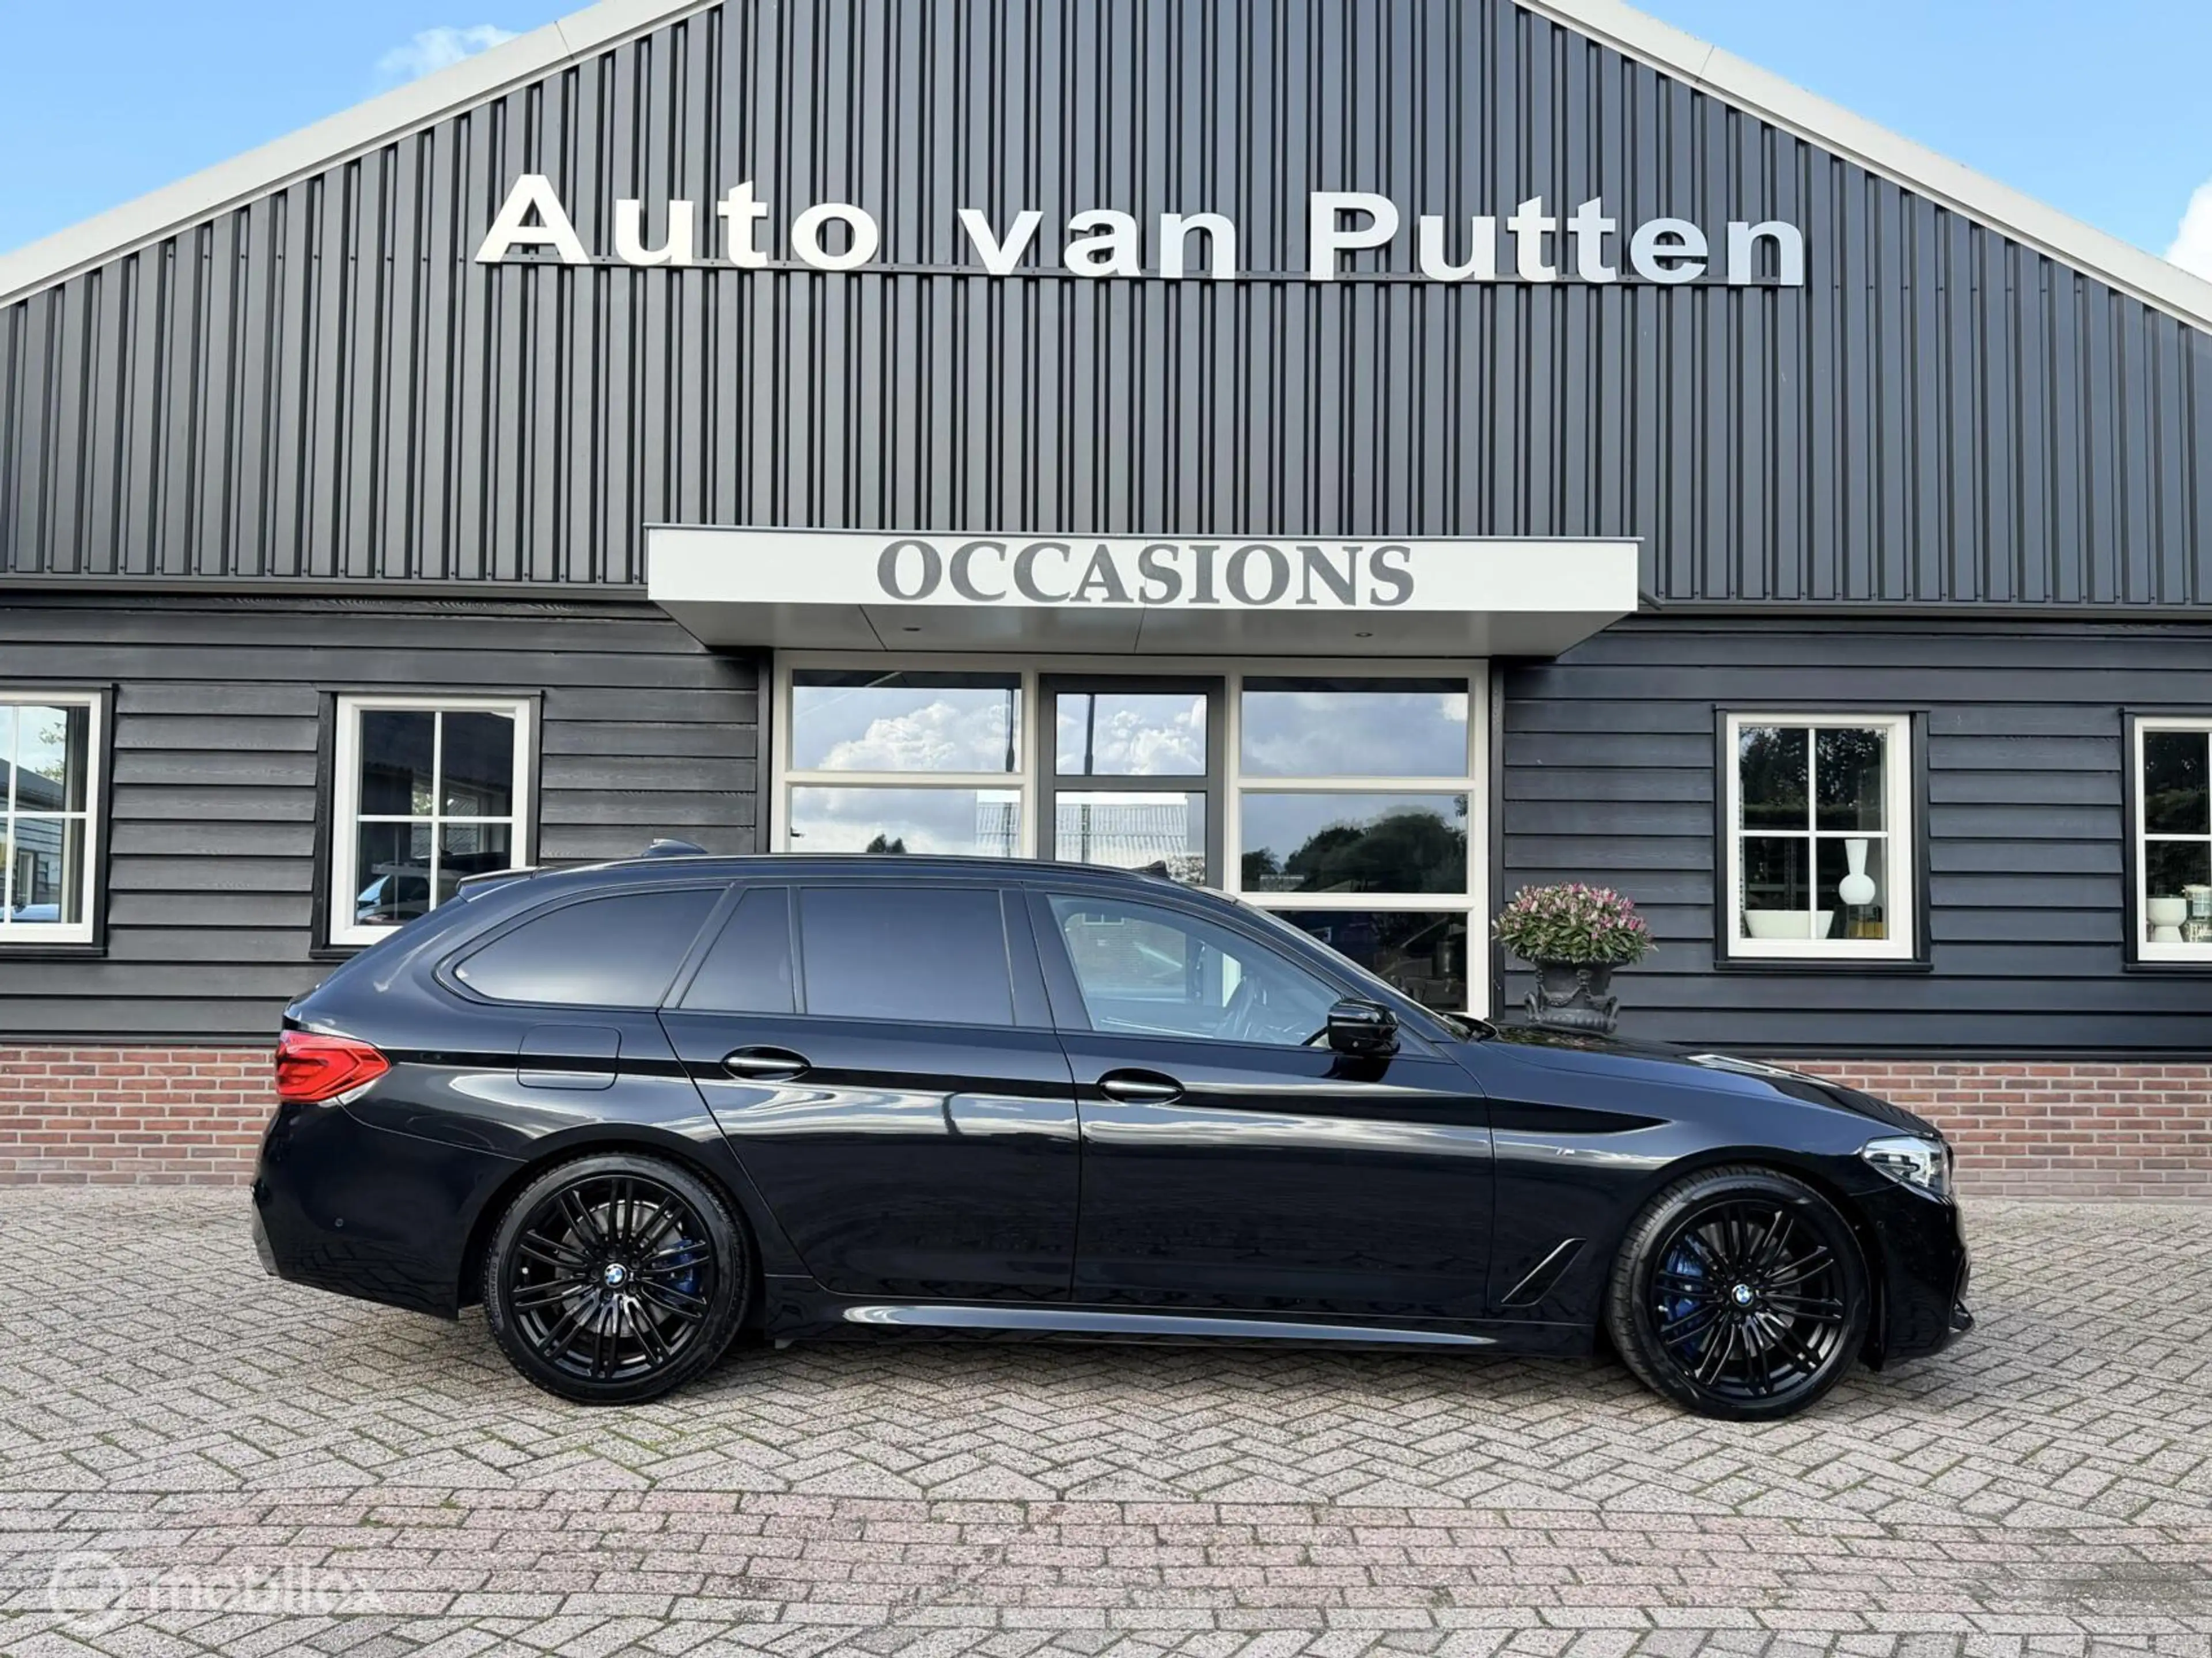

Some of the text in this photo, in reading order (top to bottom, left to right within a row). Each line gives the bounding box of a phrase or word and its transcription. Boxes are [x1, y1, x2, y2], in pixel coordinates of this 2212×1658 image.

[474, 174, 1805, 286] Auto van Putten
[877, 540, 1414, 606] OCCASIONS
